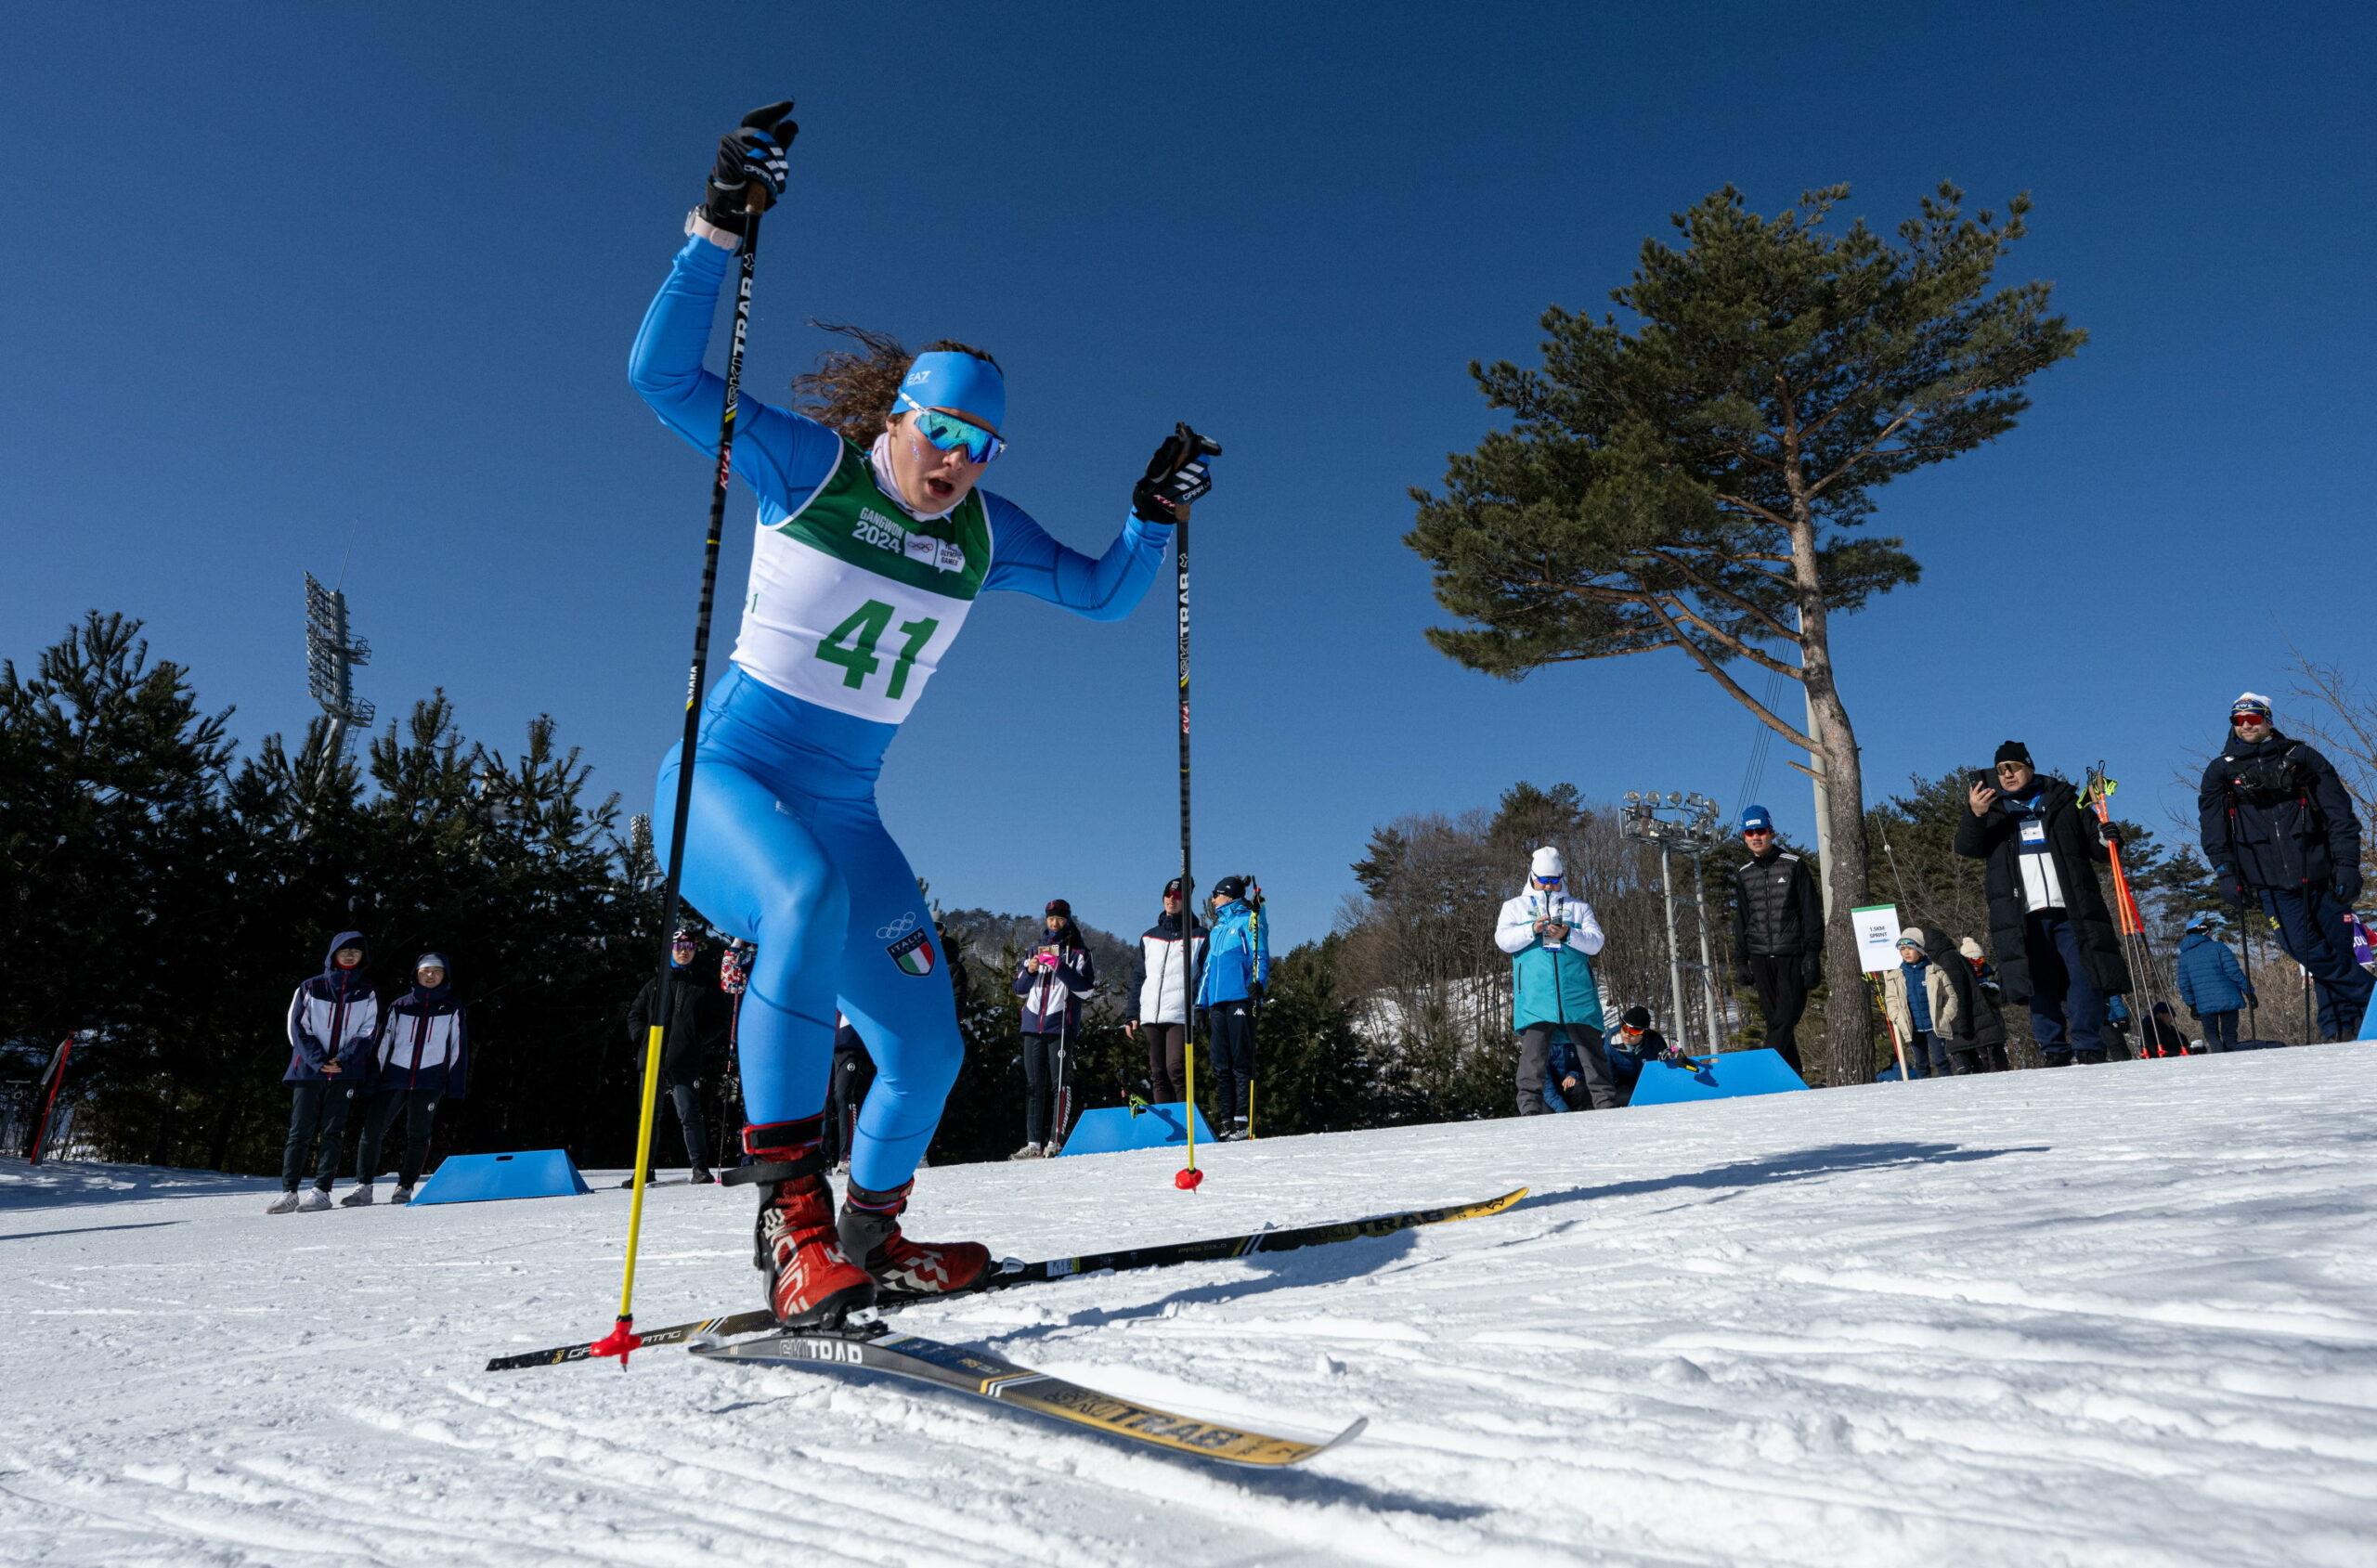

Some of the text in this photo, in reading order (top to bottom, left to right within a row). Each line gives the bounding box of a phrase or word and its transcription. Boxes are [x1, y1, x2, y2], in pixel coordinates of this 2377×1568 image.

[727, 277, 753, 407] SKITRAB
[851, 520, 901, 554] 2024
[859, 507, 904, 539] GANGWON
[815, 599, 940, 700] 41
[1179, 572, 1189, 676] SKITRAB
[890, 931, 924, 953] ITALIA
